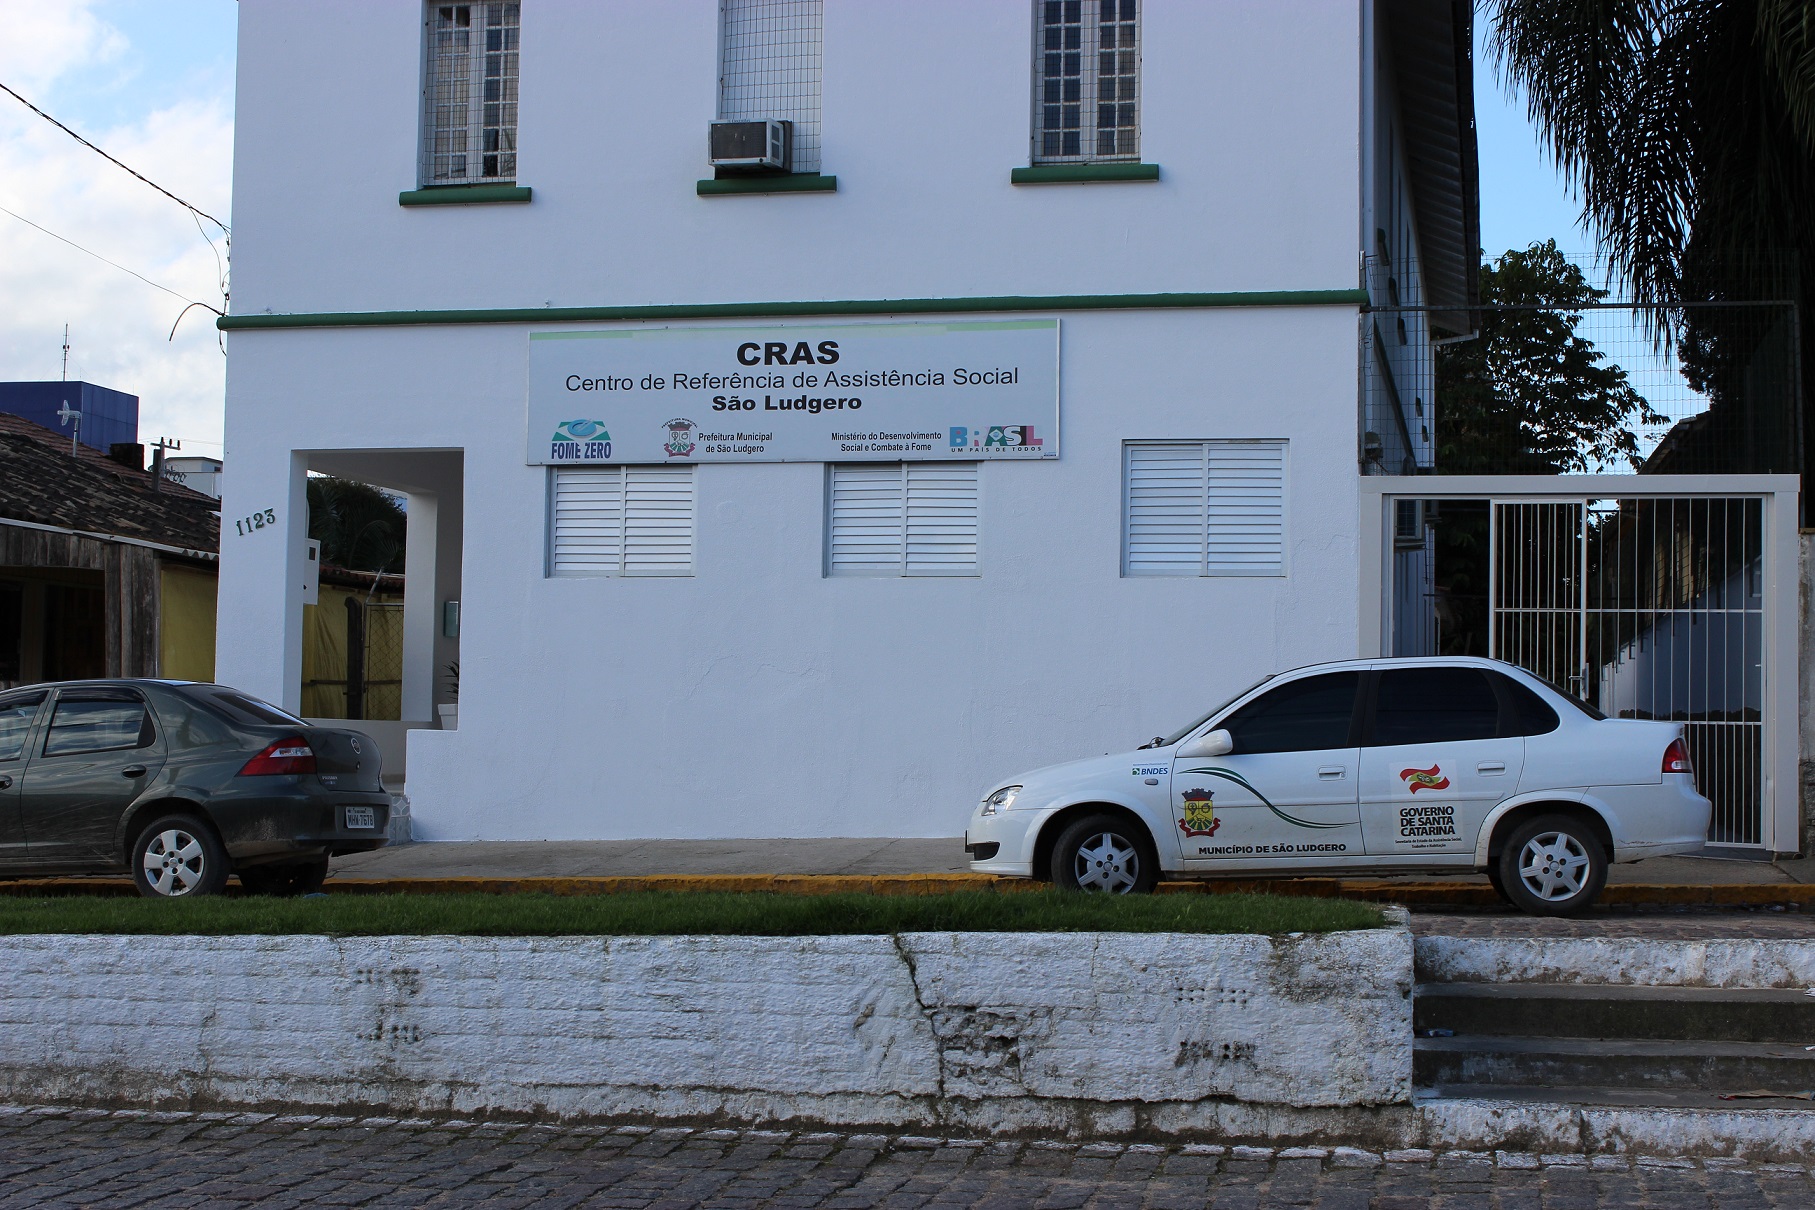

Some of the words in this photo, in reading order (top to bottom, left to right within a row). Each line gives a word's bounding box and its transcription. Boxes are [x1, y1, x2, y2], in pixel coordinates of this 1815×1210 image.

[736, 340, 841, 366] CRAS
[565, 374, 634, 392] Centro
[640, 373, 665, 390] de
[673, 371, 785, 390] Referência
[792, 371, 818, 388] de
[823, 369, 945, 388] Assistência
[952, 367, 1019, 385] Social
[711, 395, 757, 412] São
[764, 394, 862, 414] Ludgero
[698, 432, 735, 442] Prefeitura
[736, 431, 773, 442] Municipal
[831, 432, 867, 441] Ministério
[868, 431, 878, 441] do
[879, 431, 942, 440] Desenvolvimento
[949, 425, 1043, 447] BRASIL
[551, 441, 581, 459] FOME
[584, 441, 612, 459] ZERO
[705, 444, 715, 453] de
[716, 444, 731, 453] São
[733, 443, 765, 454] Ludgero
[840, 443, 863, 452] Social
[870, 443, 904, 451] Combate
[904, 443, 910, 451] à
[911, 443, 932, 451] Fome
[236, 507, 276, 537] 1123
[1140, 767, 1169, 775] BNDES
[1400, 806, 1454, 817] GOVERNO
[1400, 817, 1416, 827] DE
[1418, 816, 1454, 826] SANTA
[1400, 825, 1456, 837] CATARINA
[1198, 844, 1253, 855] MUNICÍPIO
[1255, 844, 1270, 854] DE
[1272, 842, 1294, 853] SÃO
[1296, 843, 1347, 852] LUDGERO
